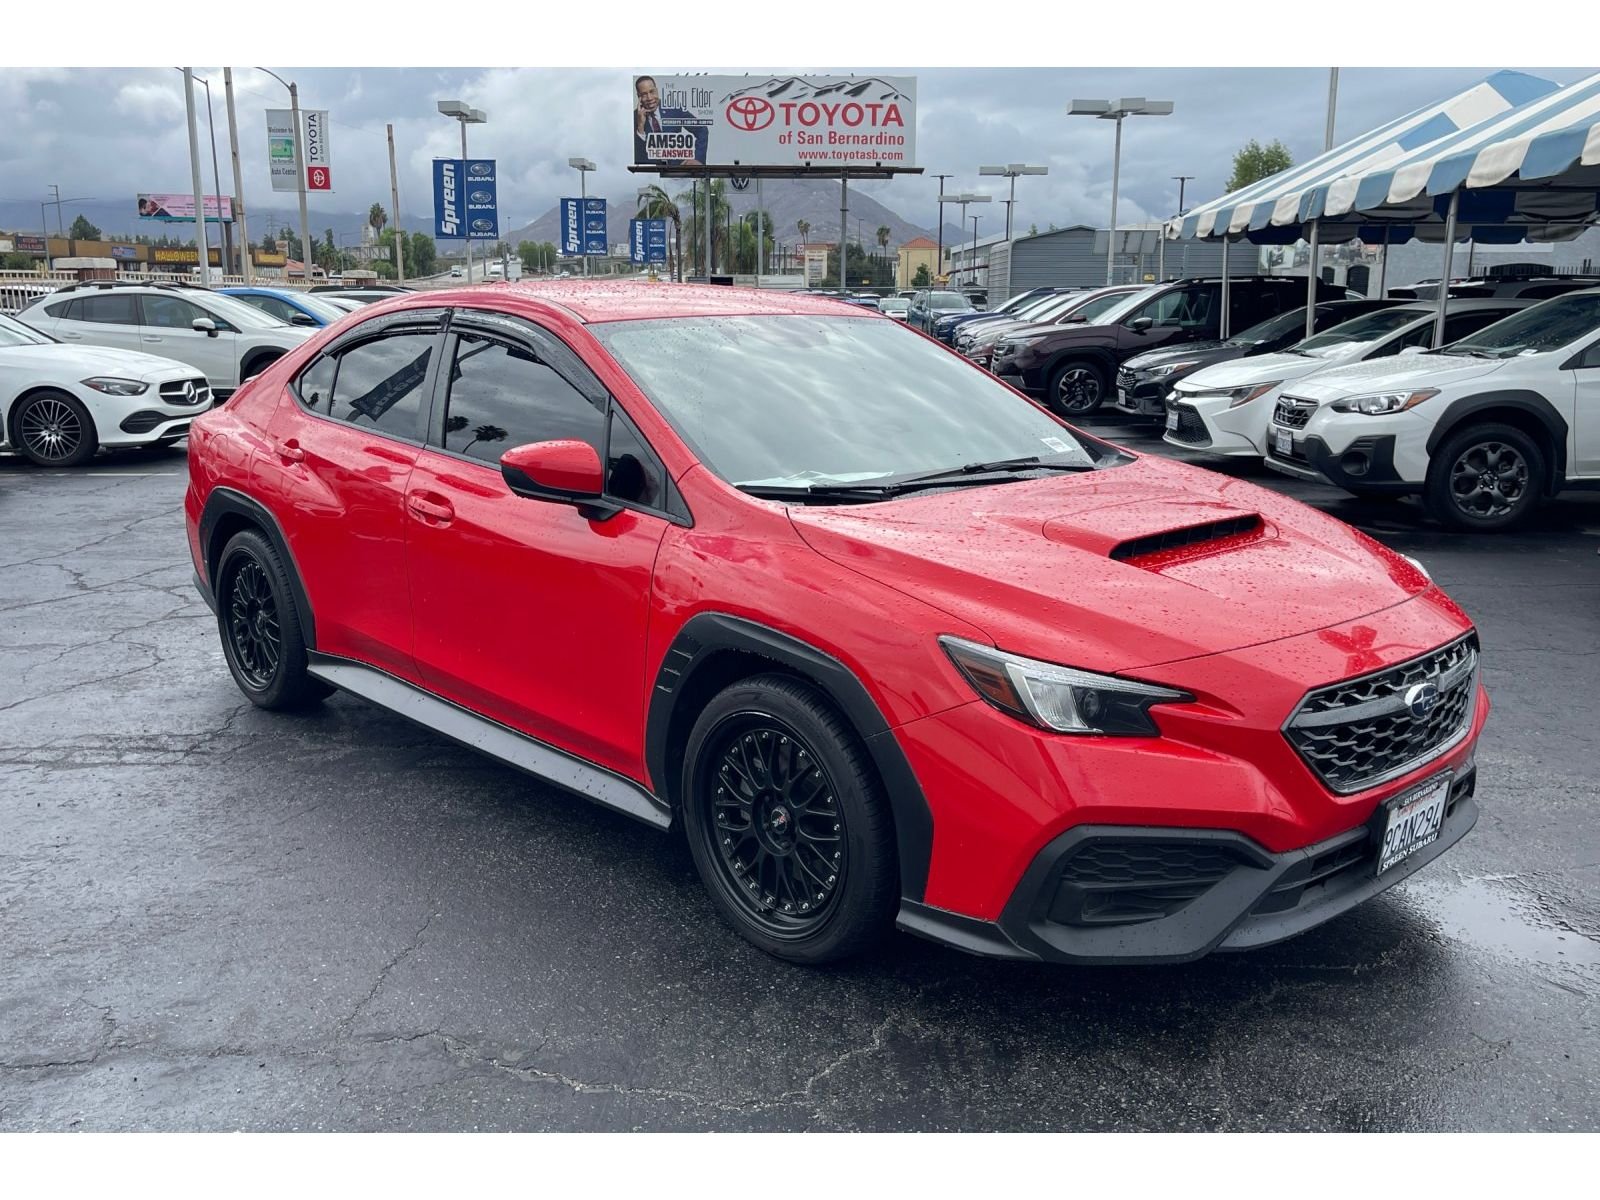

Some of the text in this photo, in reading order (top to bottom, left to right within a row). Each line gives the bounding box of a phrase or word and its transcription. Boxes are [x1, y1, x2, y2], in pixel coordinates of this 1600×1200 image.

[662, 88, 713, 110] Larry Elder
[779, 102, 904, 127] TOYOTA
[308, 113, 319, 162] TOYOTA
[648, 134, 693, 149] AM590
[779, 131, 904, 146] of San Bernardino
[798, 149, 903, 161] www.toyotasb.com
[441, 163, 460, 236] Spreen
[566, 200, 581, 253] Spreen
[634, 221, 646, 262] Spreen
[1382, 832, 1438, 870] SPREEN SUBARU
